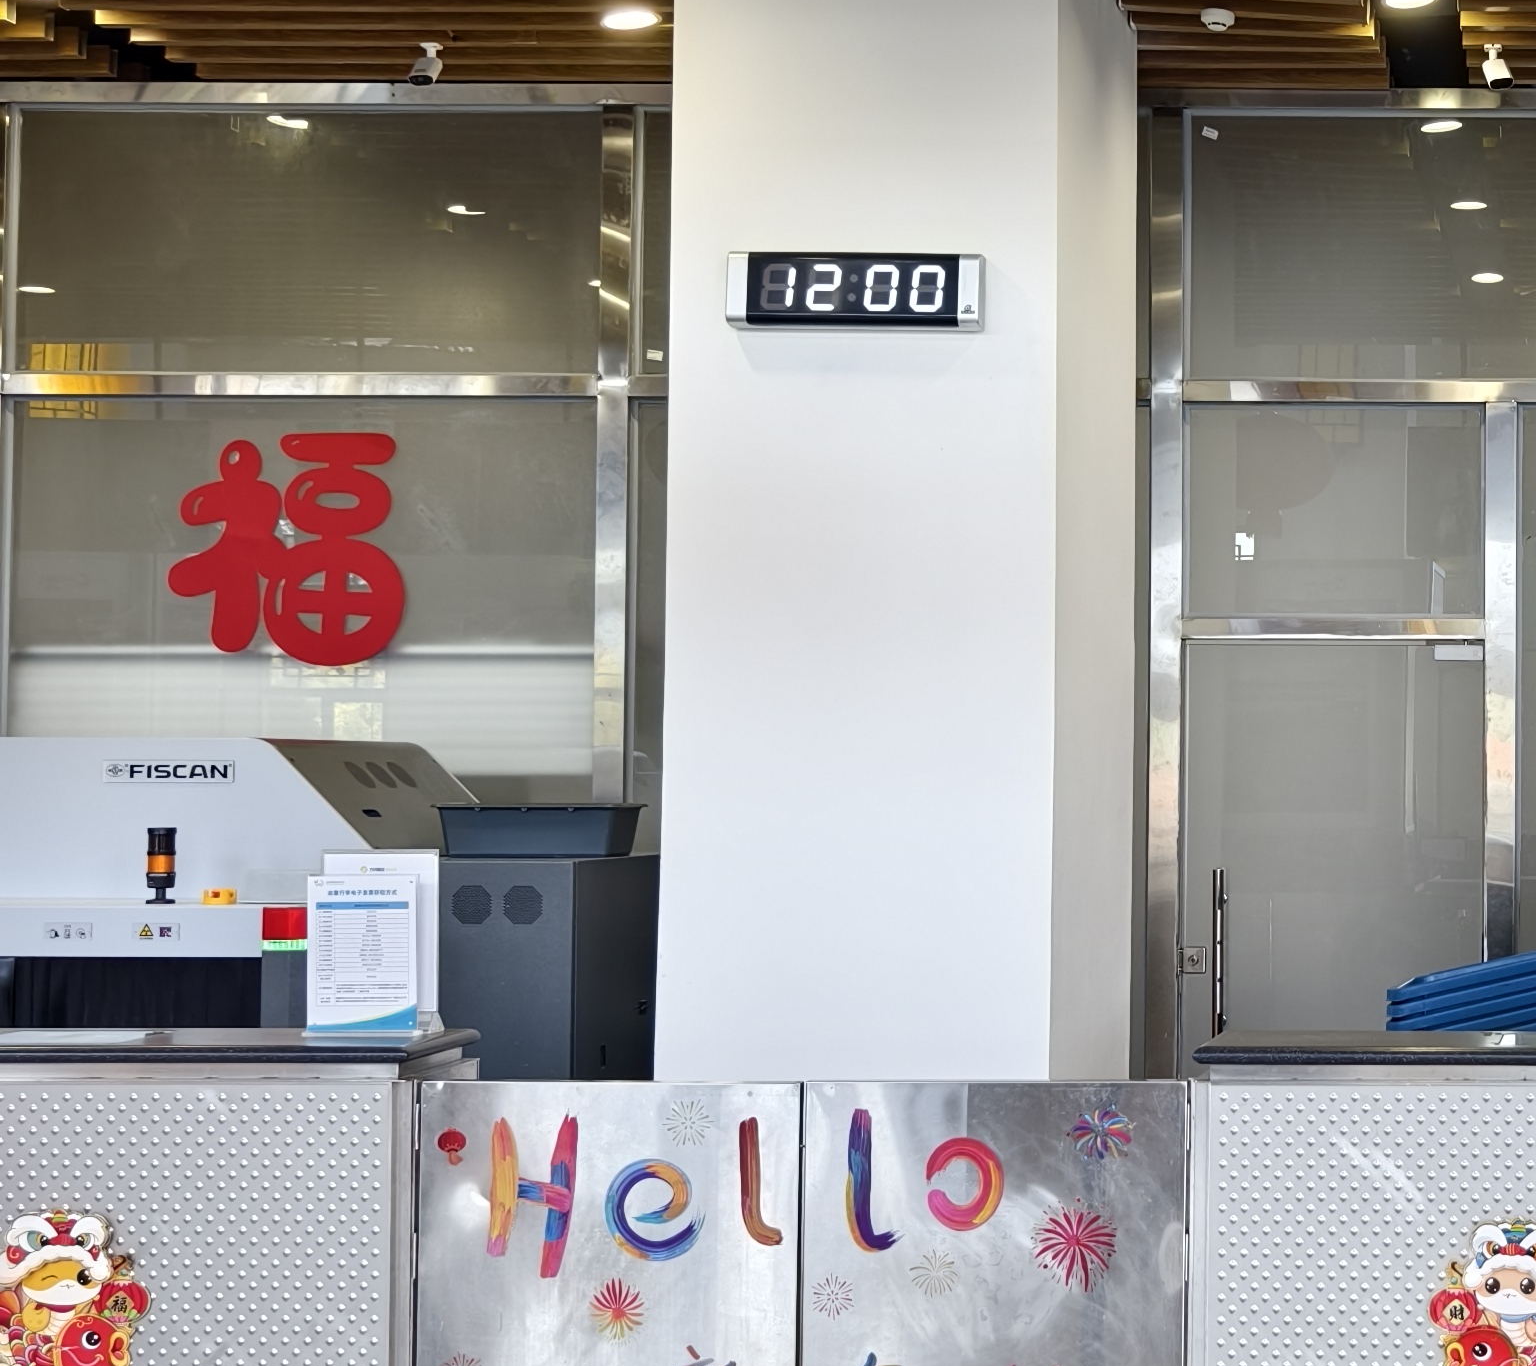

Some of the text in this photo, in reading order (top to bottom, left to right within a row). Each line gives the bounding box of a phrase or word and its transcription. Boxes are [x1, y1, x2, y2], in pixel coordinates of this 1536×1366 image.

[780, 263, 947, 313] 12:00
[166, 432, 406, 667] 福
[128, 764, 229, 780] FISCAN
[111, 1295, 129, 1314] 福
